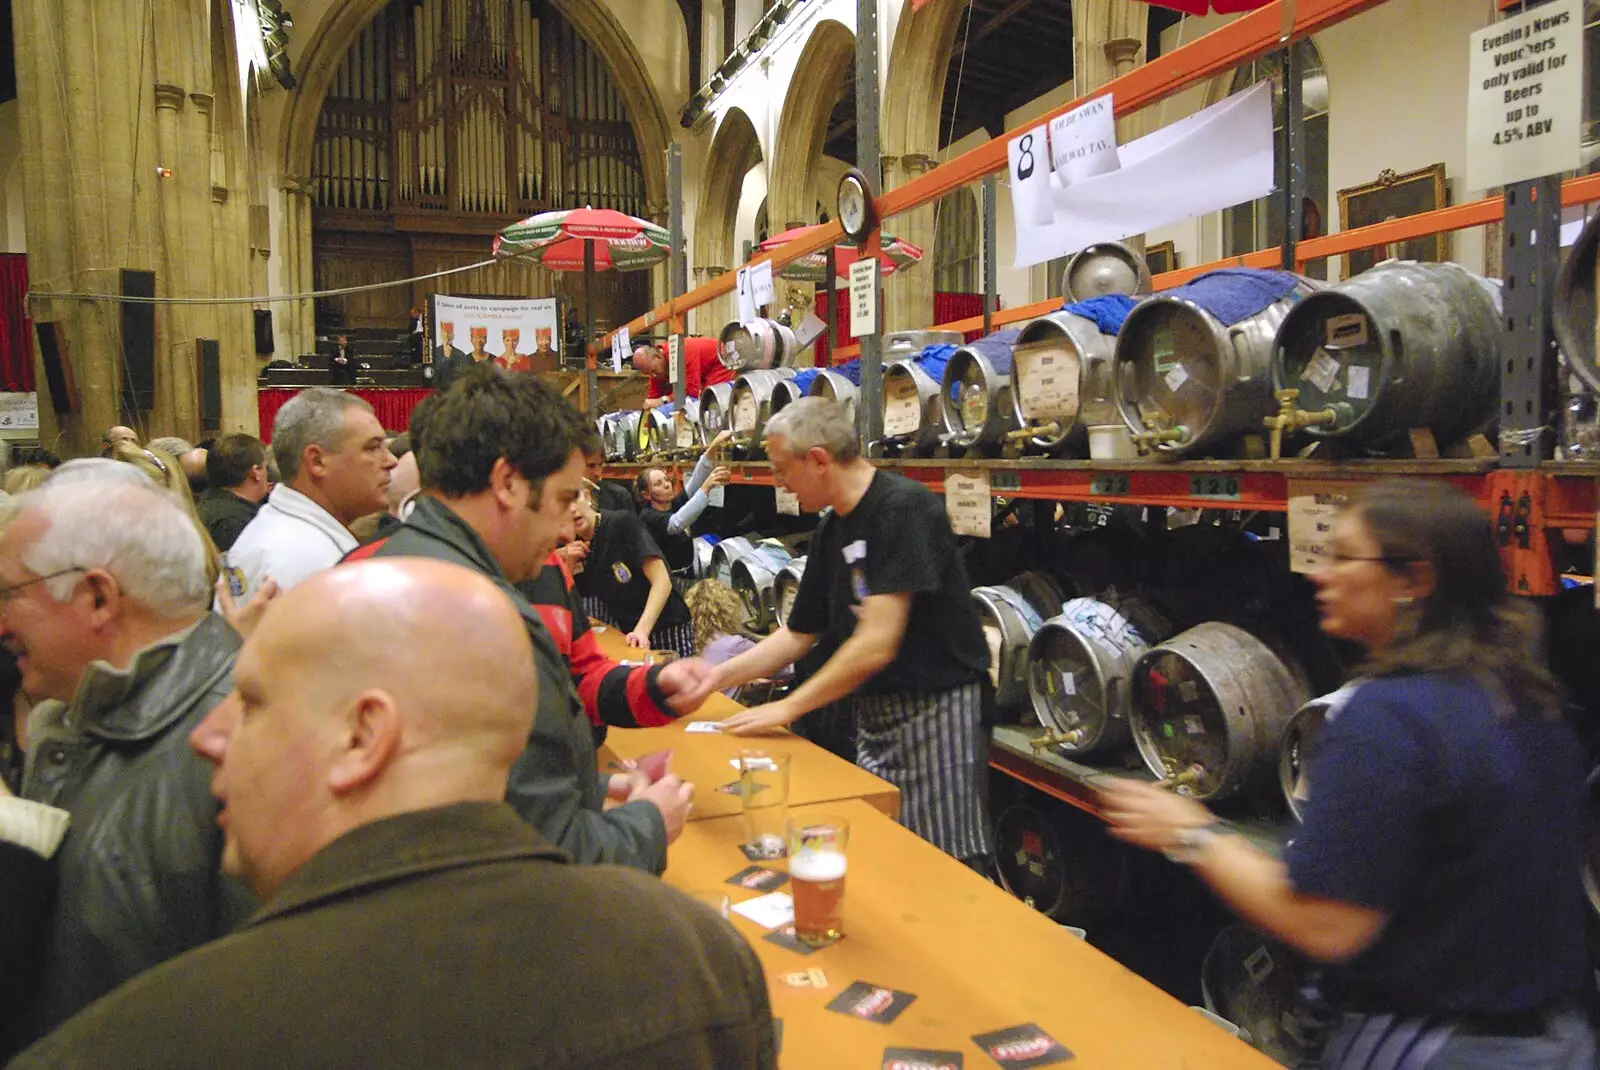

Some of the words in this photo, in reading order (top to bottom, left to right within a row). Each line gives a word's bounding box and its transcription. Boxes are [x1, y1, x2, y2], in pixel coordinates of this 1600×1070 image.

[1534, 11, 1570, 34] News
[1494, 37, 1556, 67] Voucers
[1483, 72, 1510, 90] only
[1512, 59, 1545, 81] valid
[1548, 54, 1568, 71] for
[1504, 83, 1543, 104] Beers
[1079, 101, 1105, 119] SWAN
[1506, 108, 1523, 123] up
[1526, 104, 1539, 117] to
[1492, 127, 1524, 146] 4.5%
[1526, 118, 1553, 138] ABV
[1017, 134, 1035, 181] 8
[489, 304, 520, 313] campaign
[1192, 477, 1238, 496] 120
